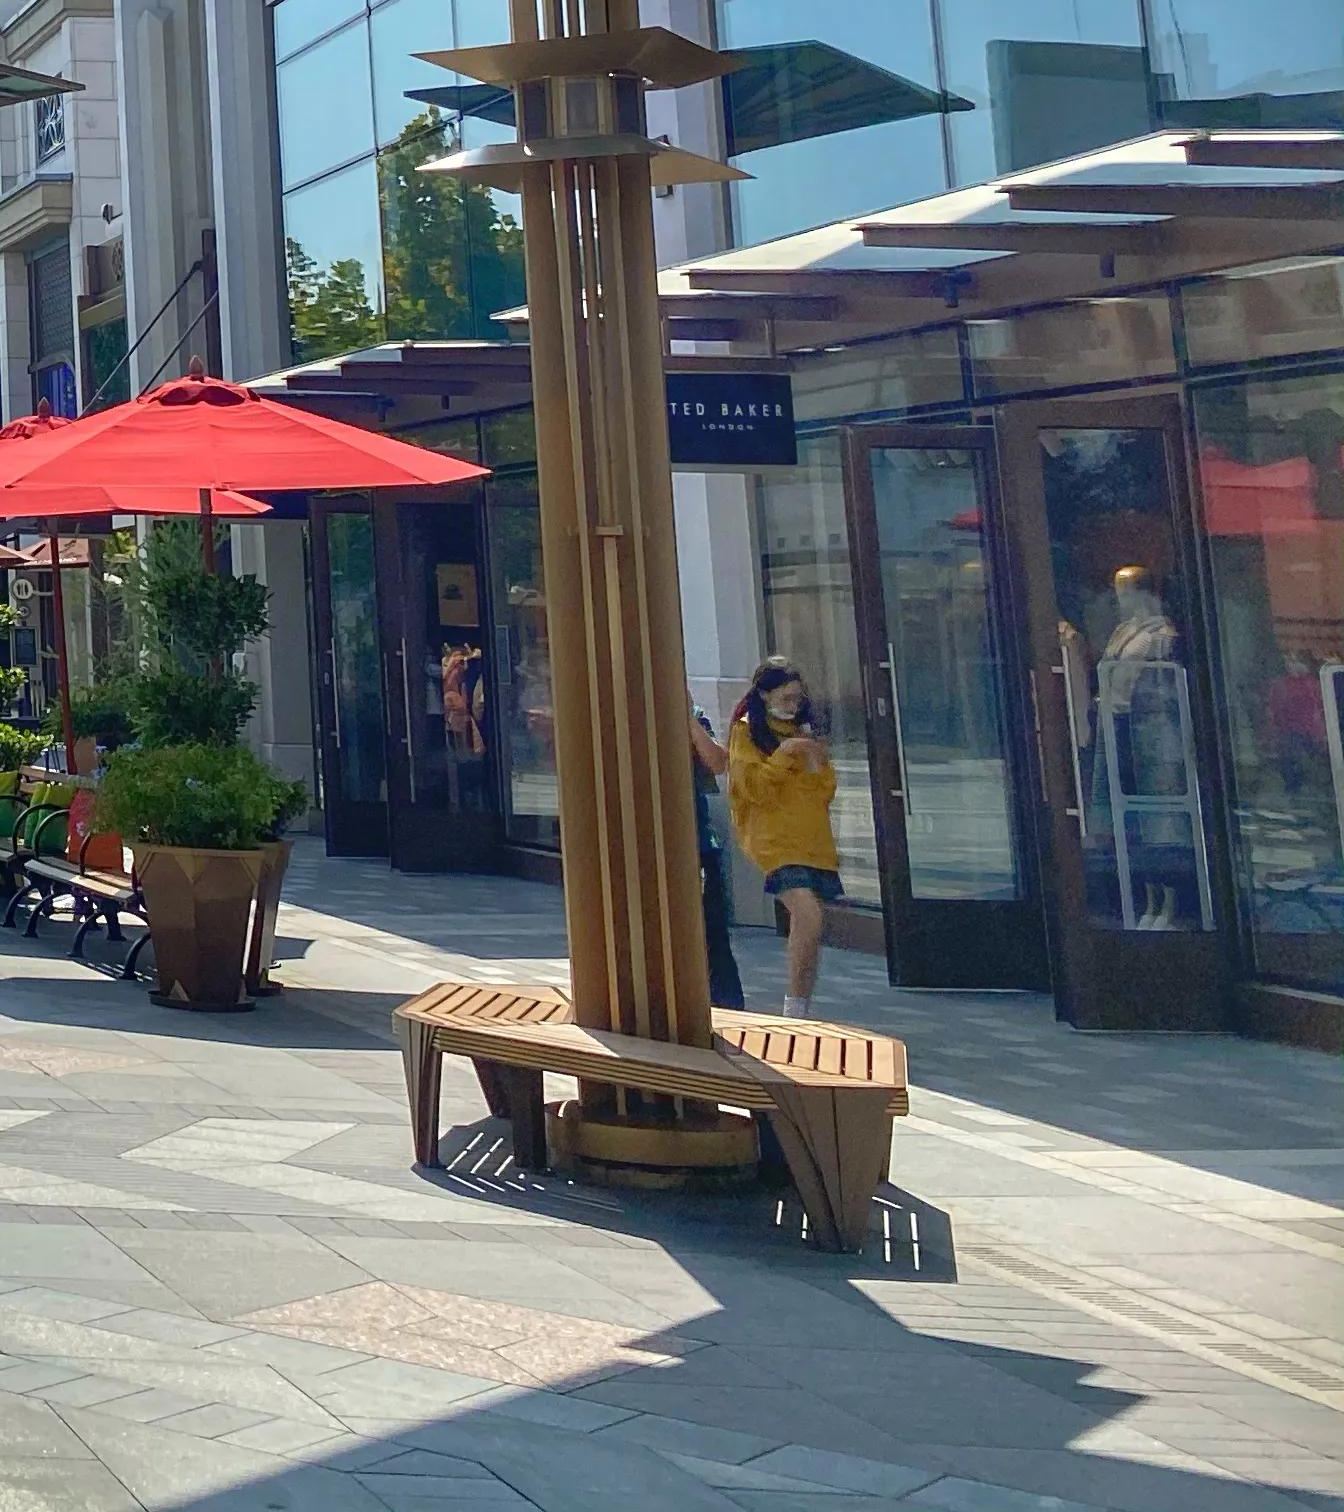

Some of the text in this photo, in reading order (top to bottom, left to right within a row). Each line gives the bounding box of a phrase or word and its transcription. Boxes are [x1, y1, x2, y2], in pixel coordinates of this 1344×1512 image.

[669, 402, 783, 418] TED BAKER
[701, 423, 754, 431] LONDON
